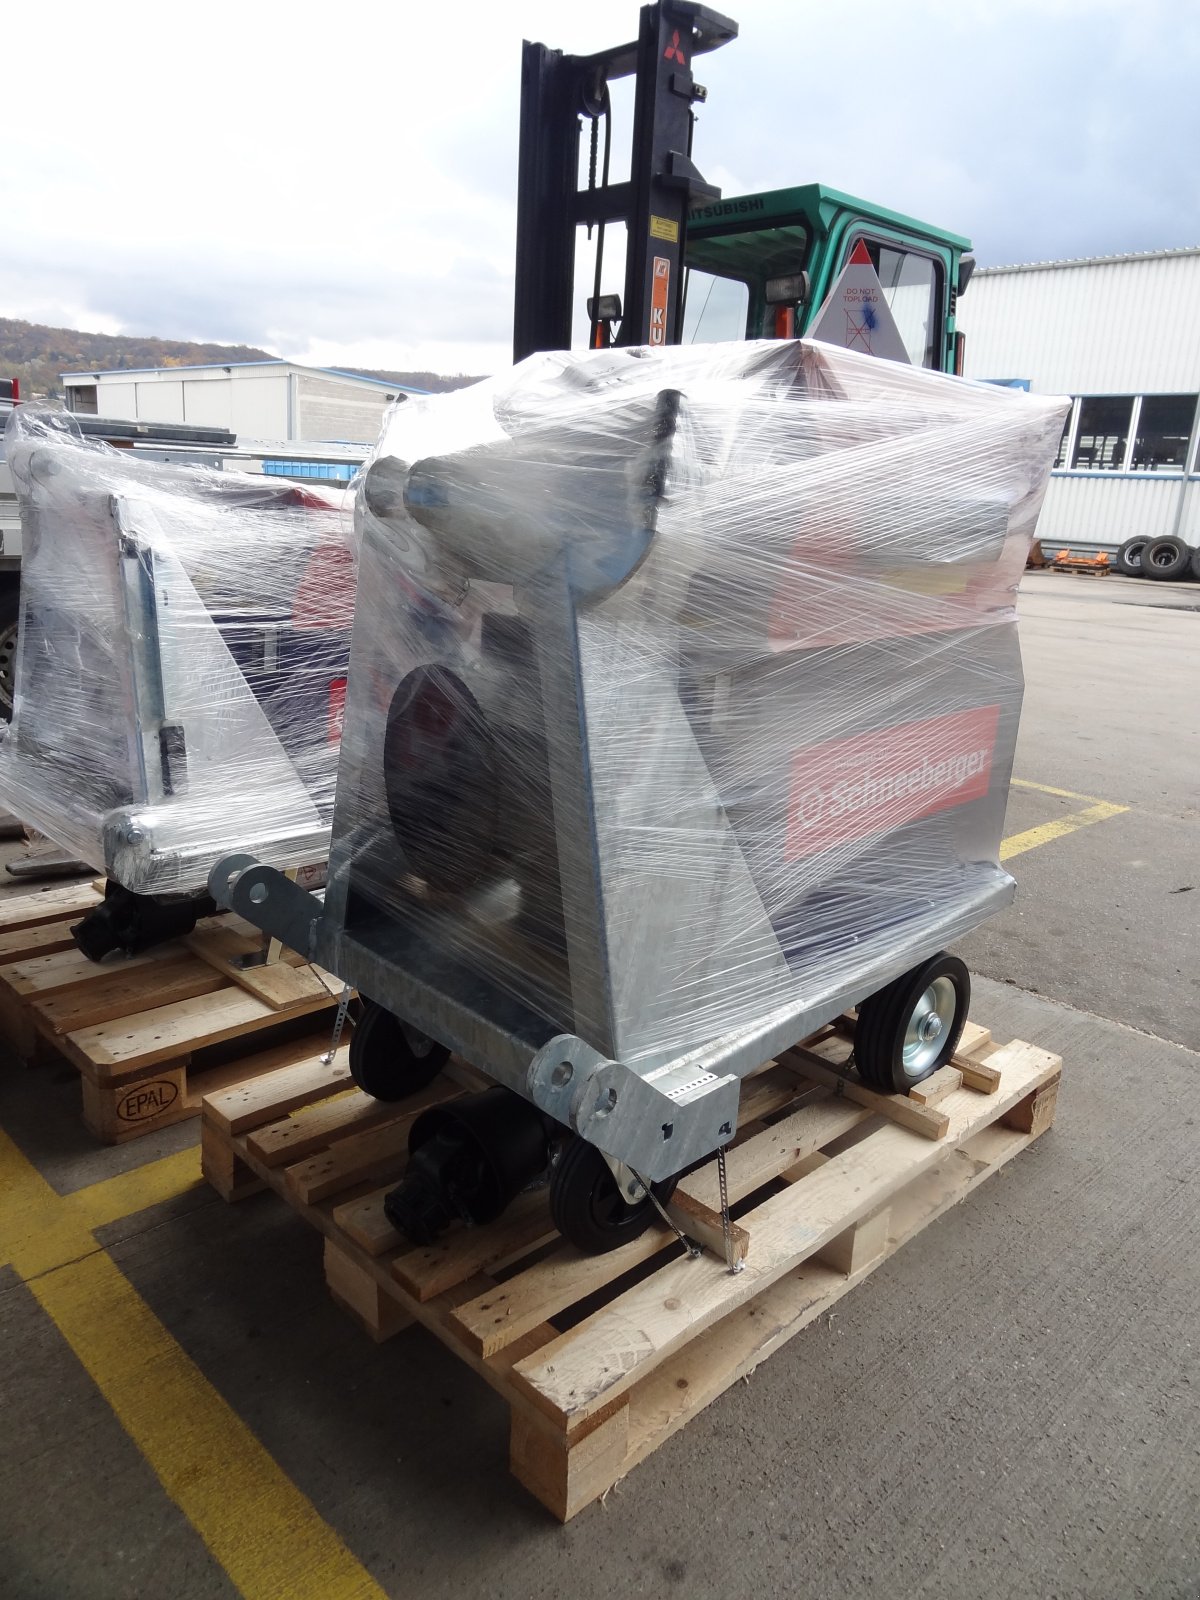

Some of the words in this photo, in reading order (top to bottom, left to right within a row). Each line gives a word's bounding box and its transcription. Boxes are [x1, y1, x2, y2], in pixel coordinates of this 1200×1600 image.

[843, 295, 879, 303] TOPLOAD
[828, 748, 989, 818] Schneeberger
[126, 1087, 170, 1117] EPAL
